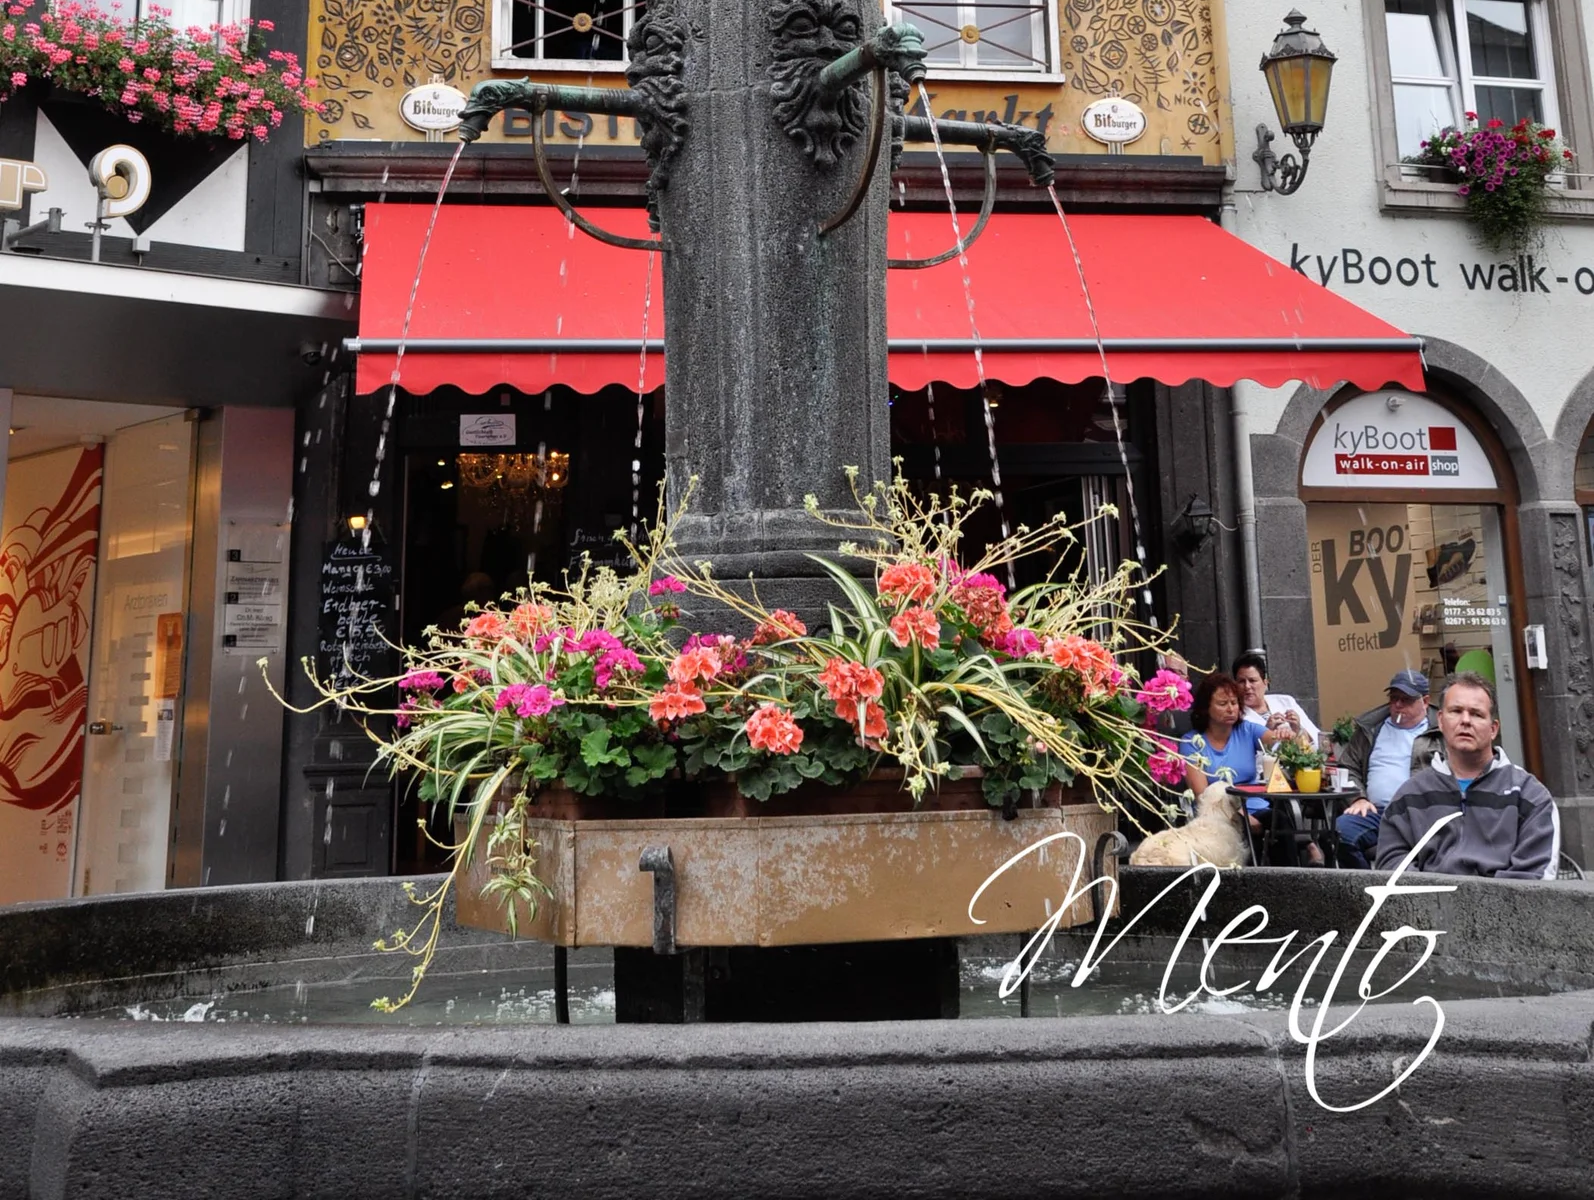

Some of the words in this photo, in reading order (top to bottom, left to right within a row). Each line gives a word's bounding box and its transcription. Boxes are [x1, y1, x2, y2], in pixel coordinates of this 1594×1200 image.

[1093, 113, 1137, 130] Bitburger
[1290, 243, 1439, 288] kyBoot
[1334, 422, 1428, 456] kyBoot
[1339, 457, 1425, 471] walk-on-air
[1432, 458, 1459, 473] shop
[1350, 524, 1412, 557] BOO
[1312, 541, 1322, 573] DER
[1444, 608, 1461, 616] 0177
[1338, 632, 1379, 652] effekt
